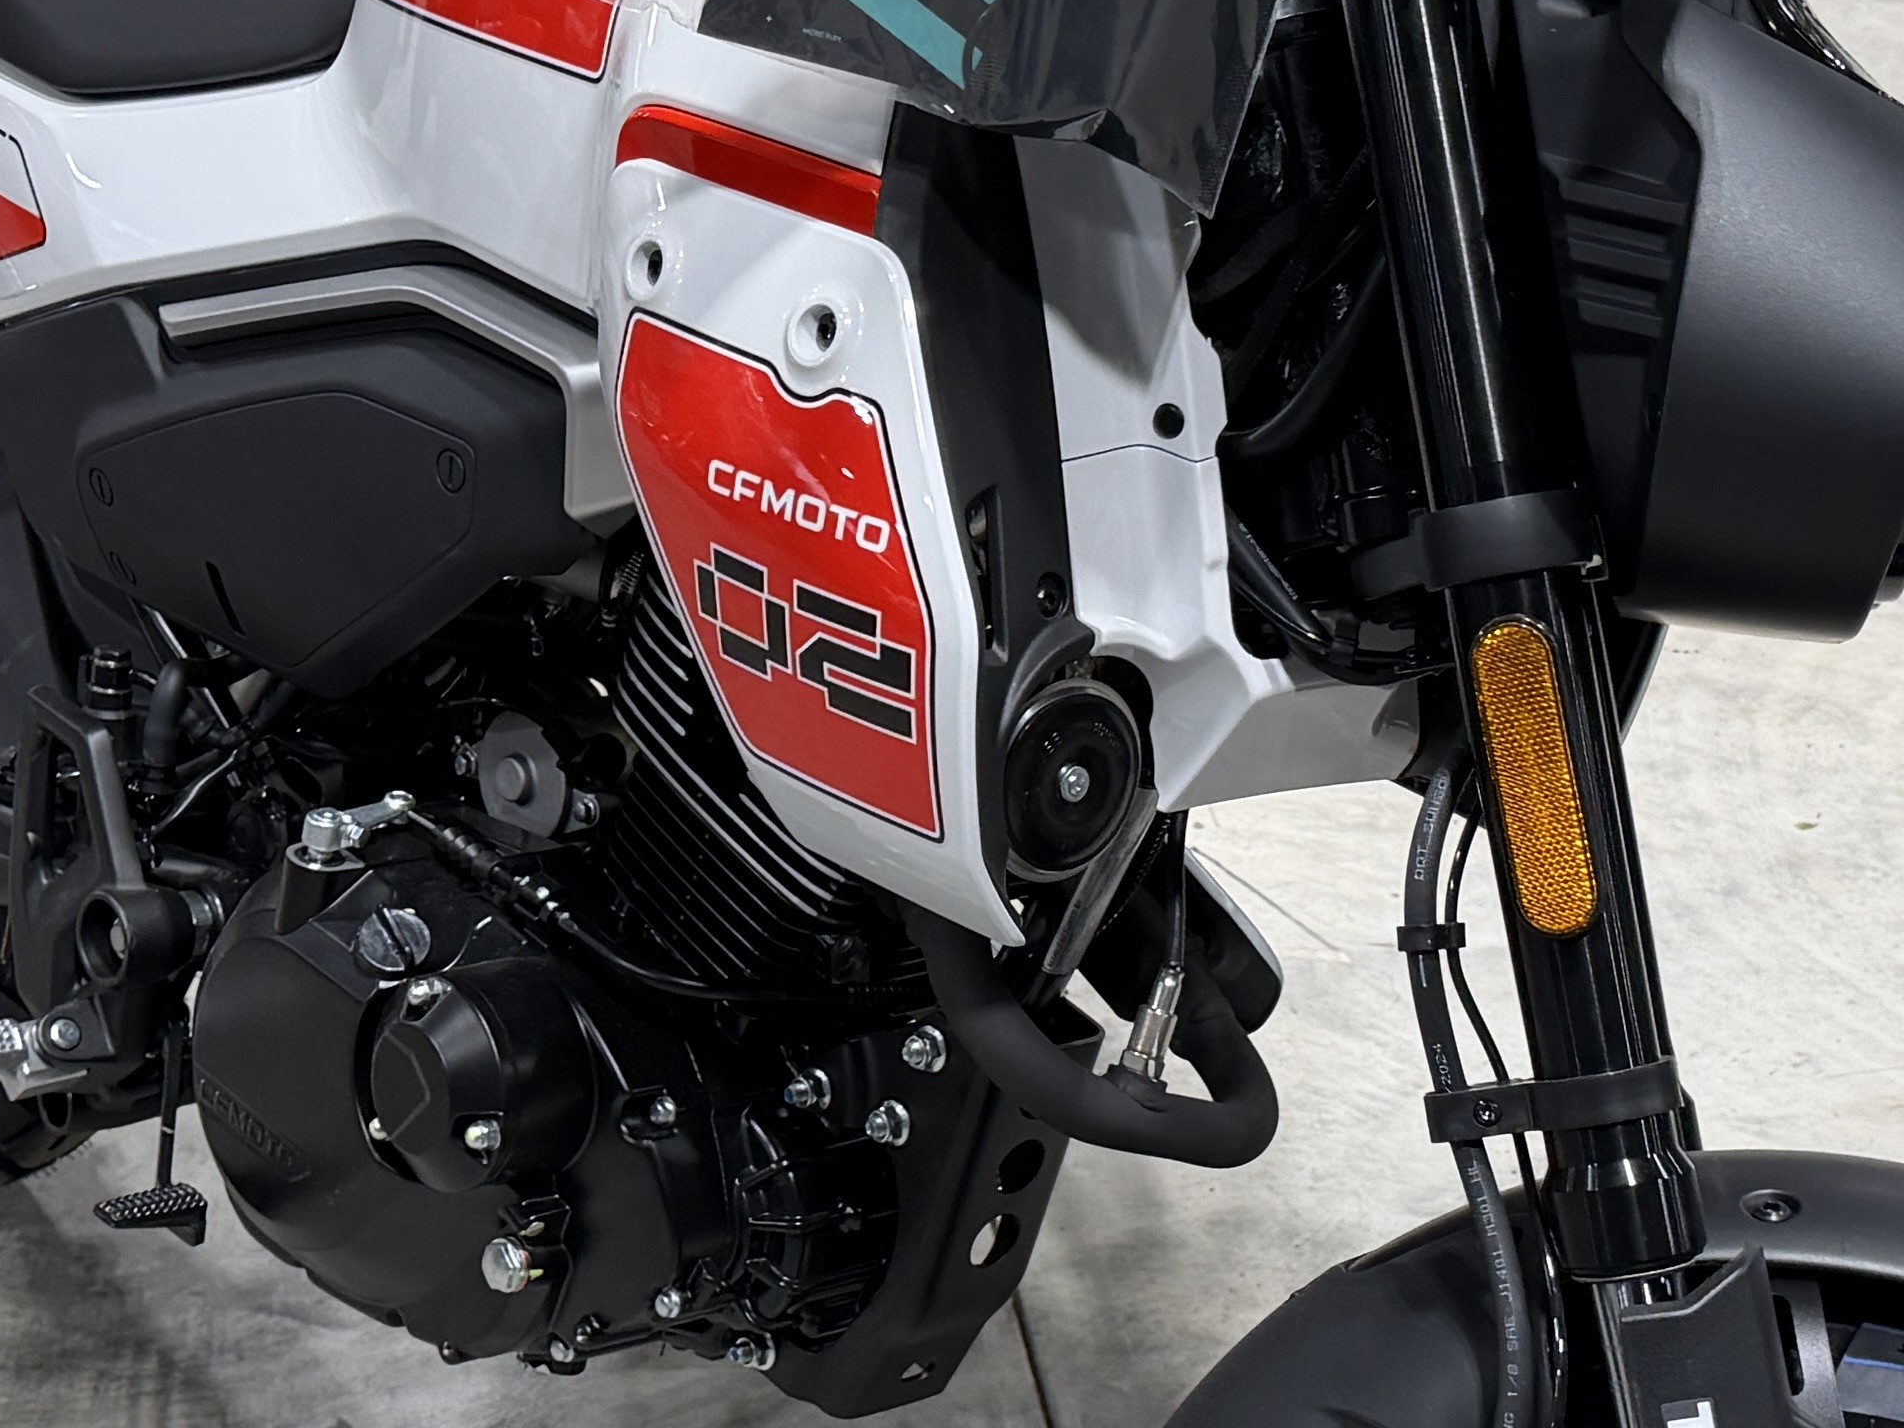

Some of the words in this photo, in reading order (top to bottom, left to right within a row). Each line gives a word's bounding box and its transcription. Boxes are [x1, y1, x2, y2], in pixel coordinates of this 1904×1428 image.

[707, 458, 890, 555] CFMOTO
[693, 542, 917, 745] 02
[1506, 1363, 1519, 1397] 1/8
